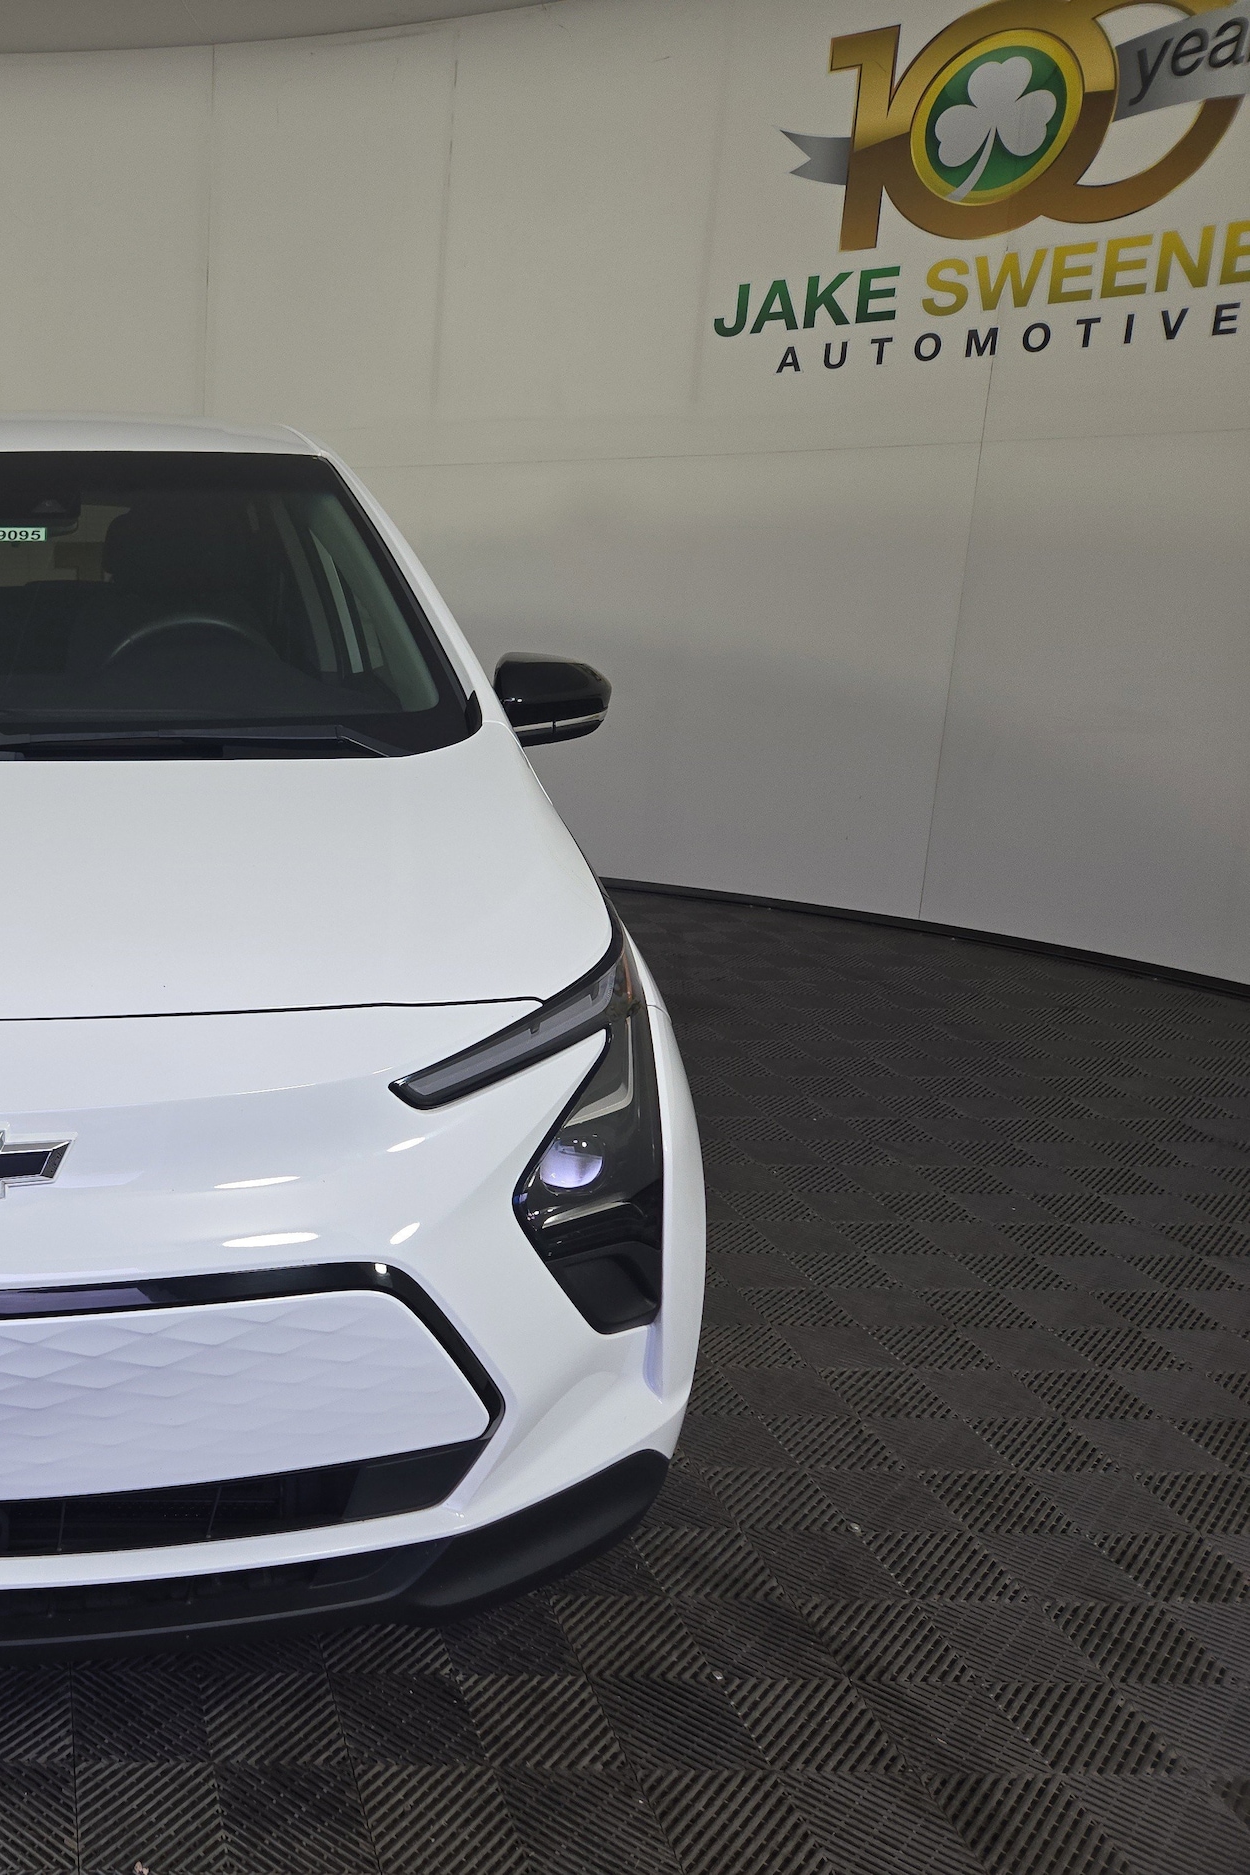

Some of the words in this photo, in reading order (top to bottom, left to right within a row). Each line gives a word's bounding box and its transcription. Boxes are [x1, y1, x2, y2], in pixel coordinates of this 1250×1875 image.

[1129, 16, 1250, 106] yea
[713, 266, 901, 337] JAKE
[776, 302, 1241, 374] AUTOMOTIVE
